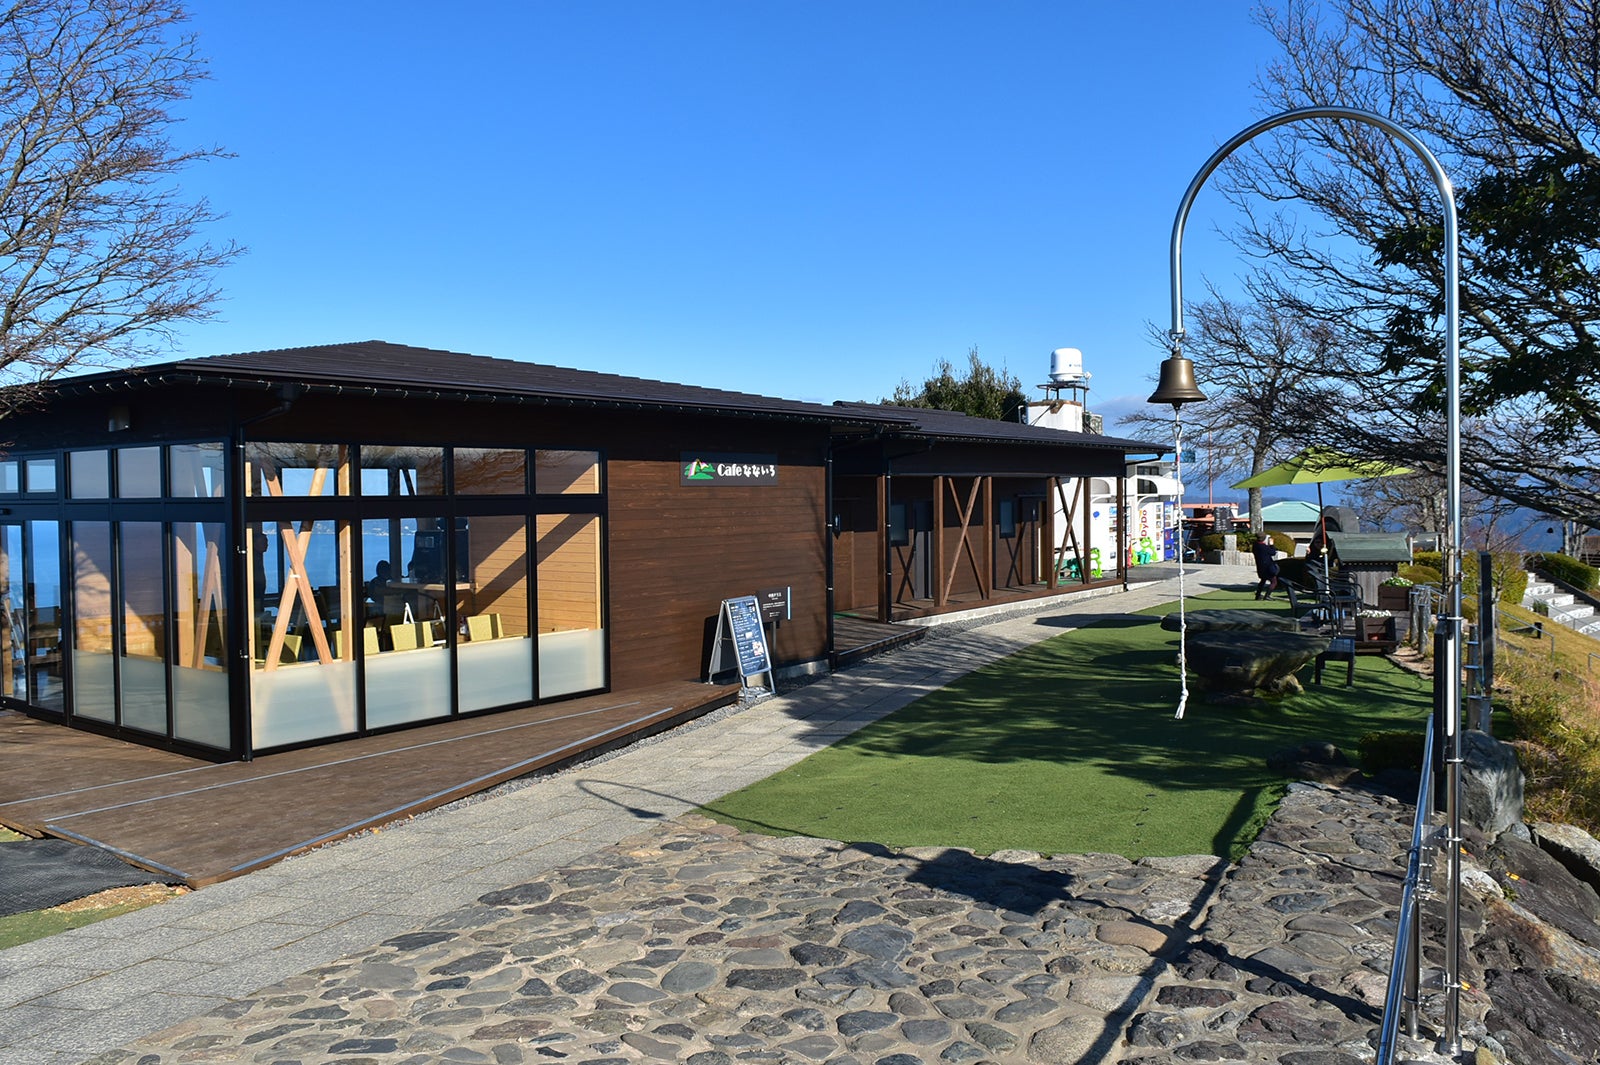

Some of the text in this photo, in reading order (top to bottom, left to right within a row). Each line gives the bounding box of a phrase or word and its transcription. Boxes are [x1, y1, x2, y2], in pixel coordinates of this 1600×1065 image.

[717, 463, 775, 478] Cafe なないろ
[1140, 509, 1149, 537] DyDo
